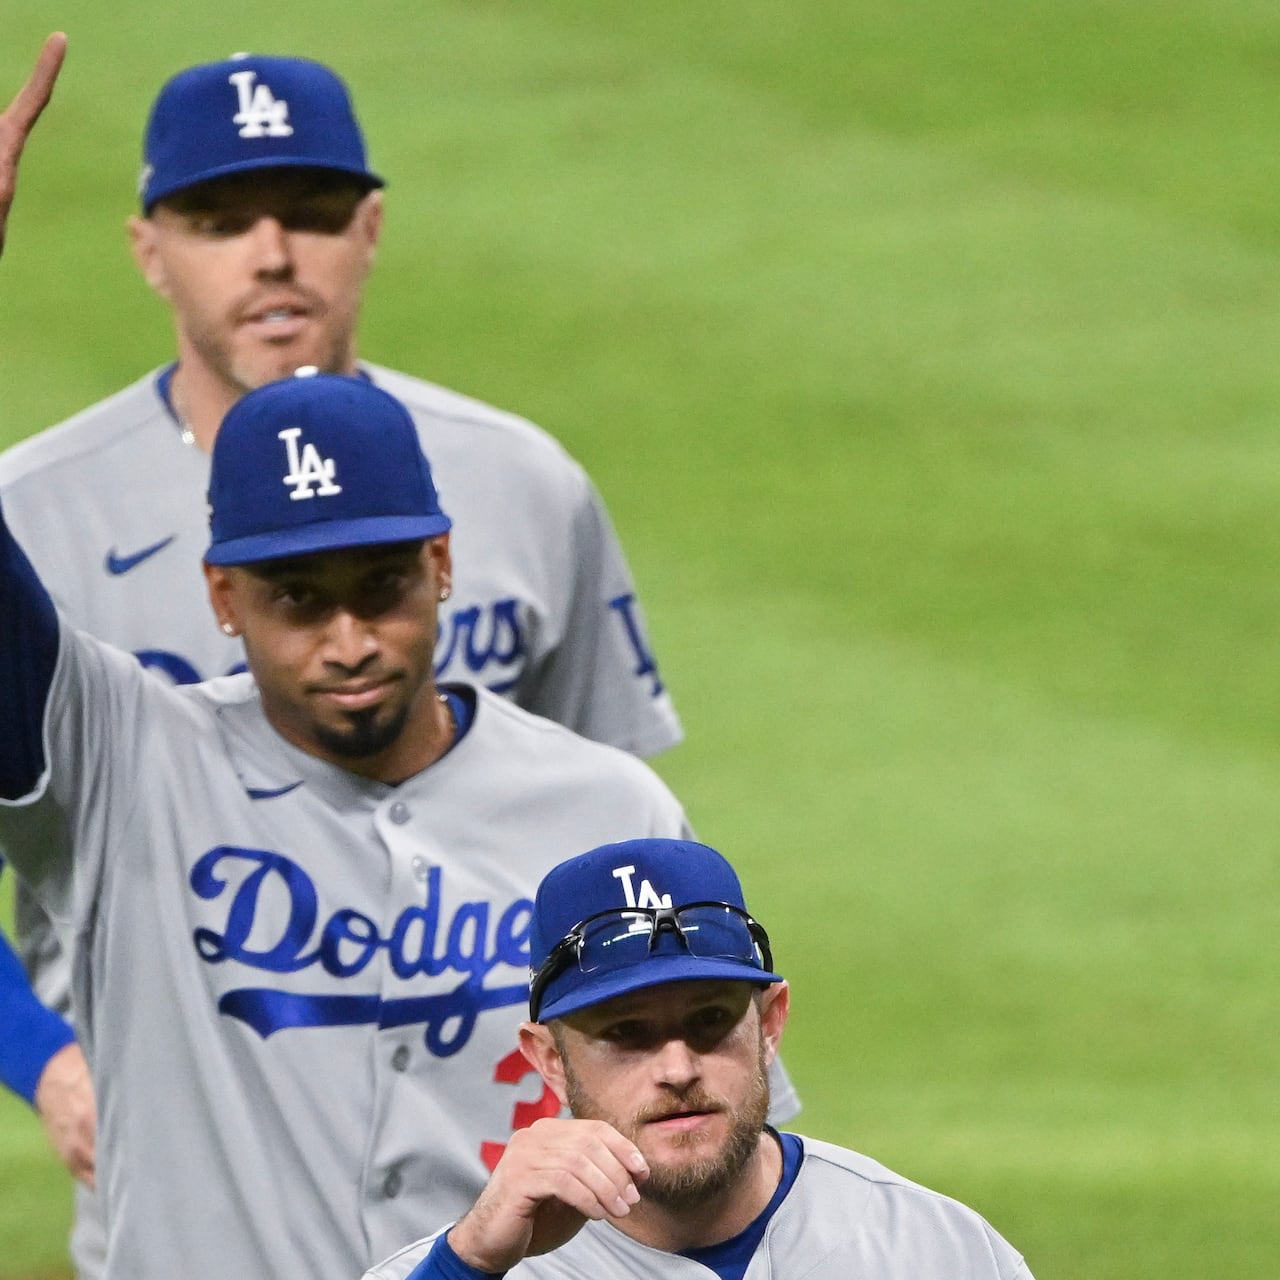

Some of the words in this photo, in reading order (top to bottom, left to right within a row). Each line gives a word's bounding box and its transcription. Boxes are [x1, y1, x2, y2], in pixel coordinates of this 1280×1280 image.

[228, 71, 294, 138] LA
[278, 428, 342, 500] LA
[613, 865, 673, 932] LA
